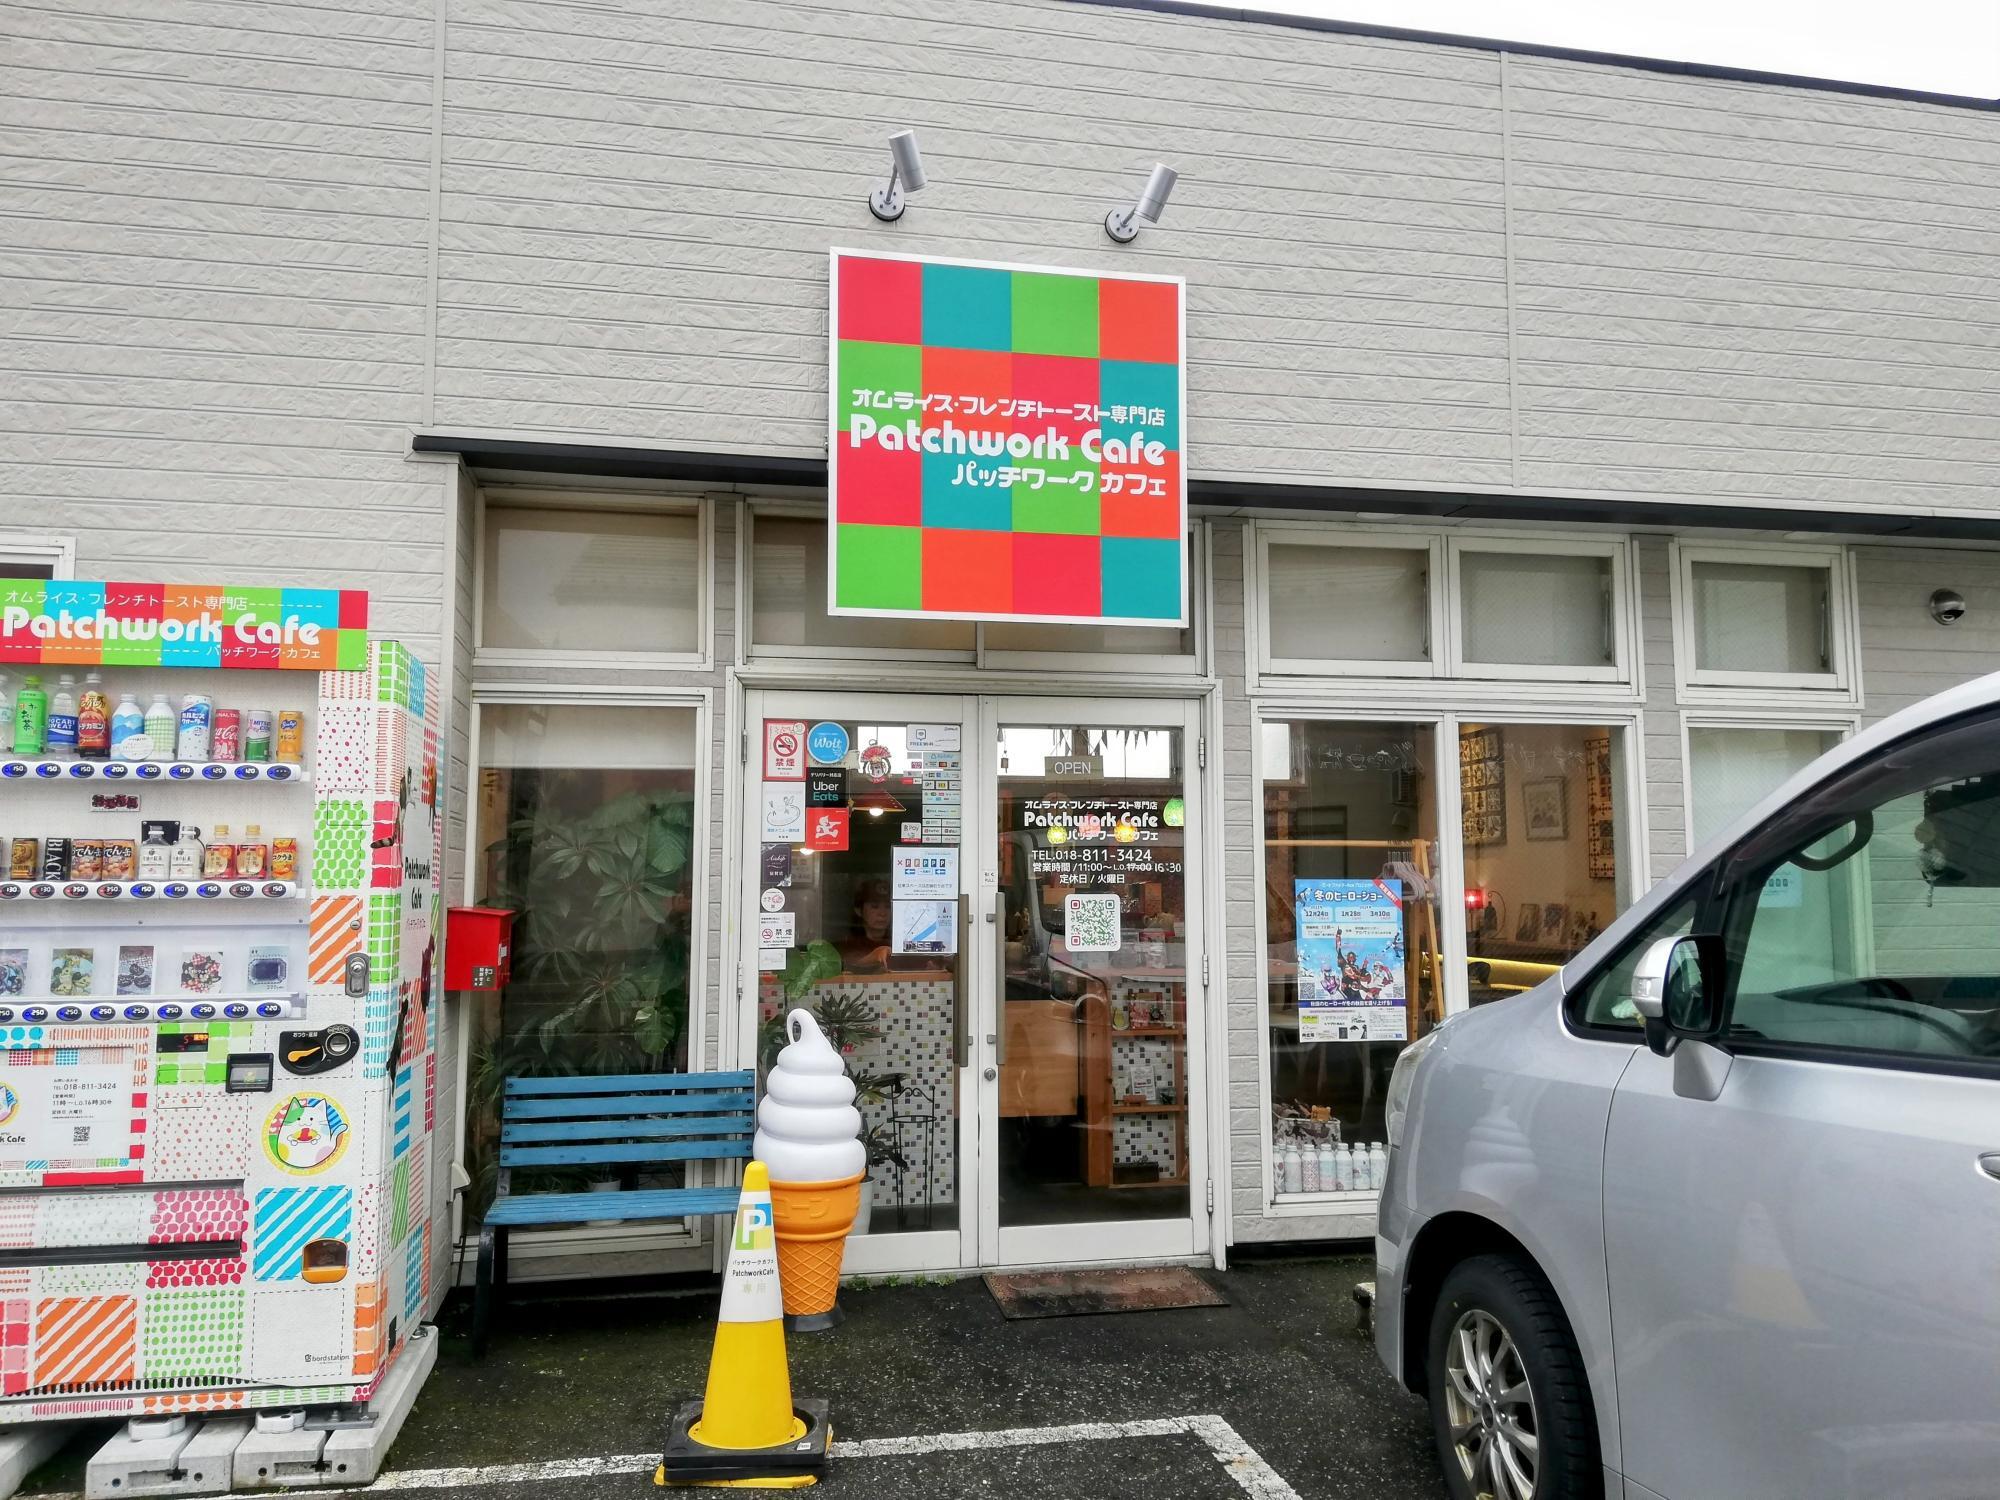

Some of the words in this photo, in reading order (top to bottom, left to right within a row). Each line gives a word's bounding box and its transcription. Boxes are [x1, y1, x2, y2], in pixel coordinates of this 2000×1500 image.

[852, 388, 1166, 427] オムライス・フレンチトースト専門店
[850, 412, 1070, 461] Patchwork
[1080, 427, 1167, 466] Cafe
[951, 460, 1095, 492] パッチワーク
[1100, 471, 1167, 496] カフェ
[5, 590, 249, 612] オムライス・フレンチトースト専門店
[2, 605, 223, 644] Patchwork
[234, 612, 320, 645] Cafe
[1054, 761, 1091, 775] OPEN
[813, 781, 839, 791] Uber
[813, 791, 839, 801] Eats
[1024, 800, 1158, 811] オムライス・フレンチトースト専門店
[1024, 811, 1117, 827] Patchwork
[1120, 811, 1158, 828] Cafe
[1033, 862, 1071, 872] 営業時間
[1060, 873, 1088, 884] 定休日
[1097, 873, 1125, 884] 火曜日
[1314, 889, 1384, 902] 冬のヒーローショー
[742, 1209, 767, 1244] P
